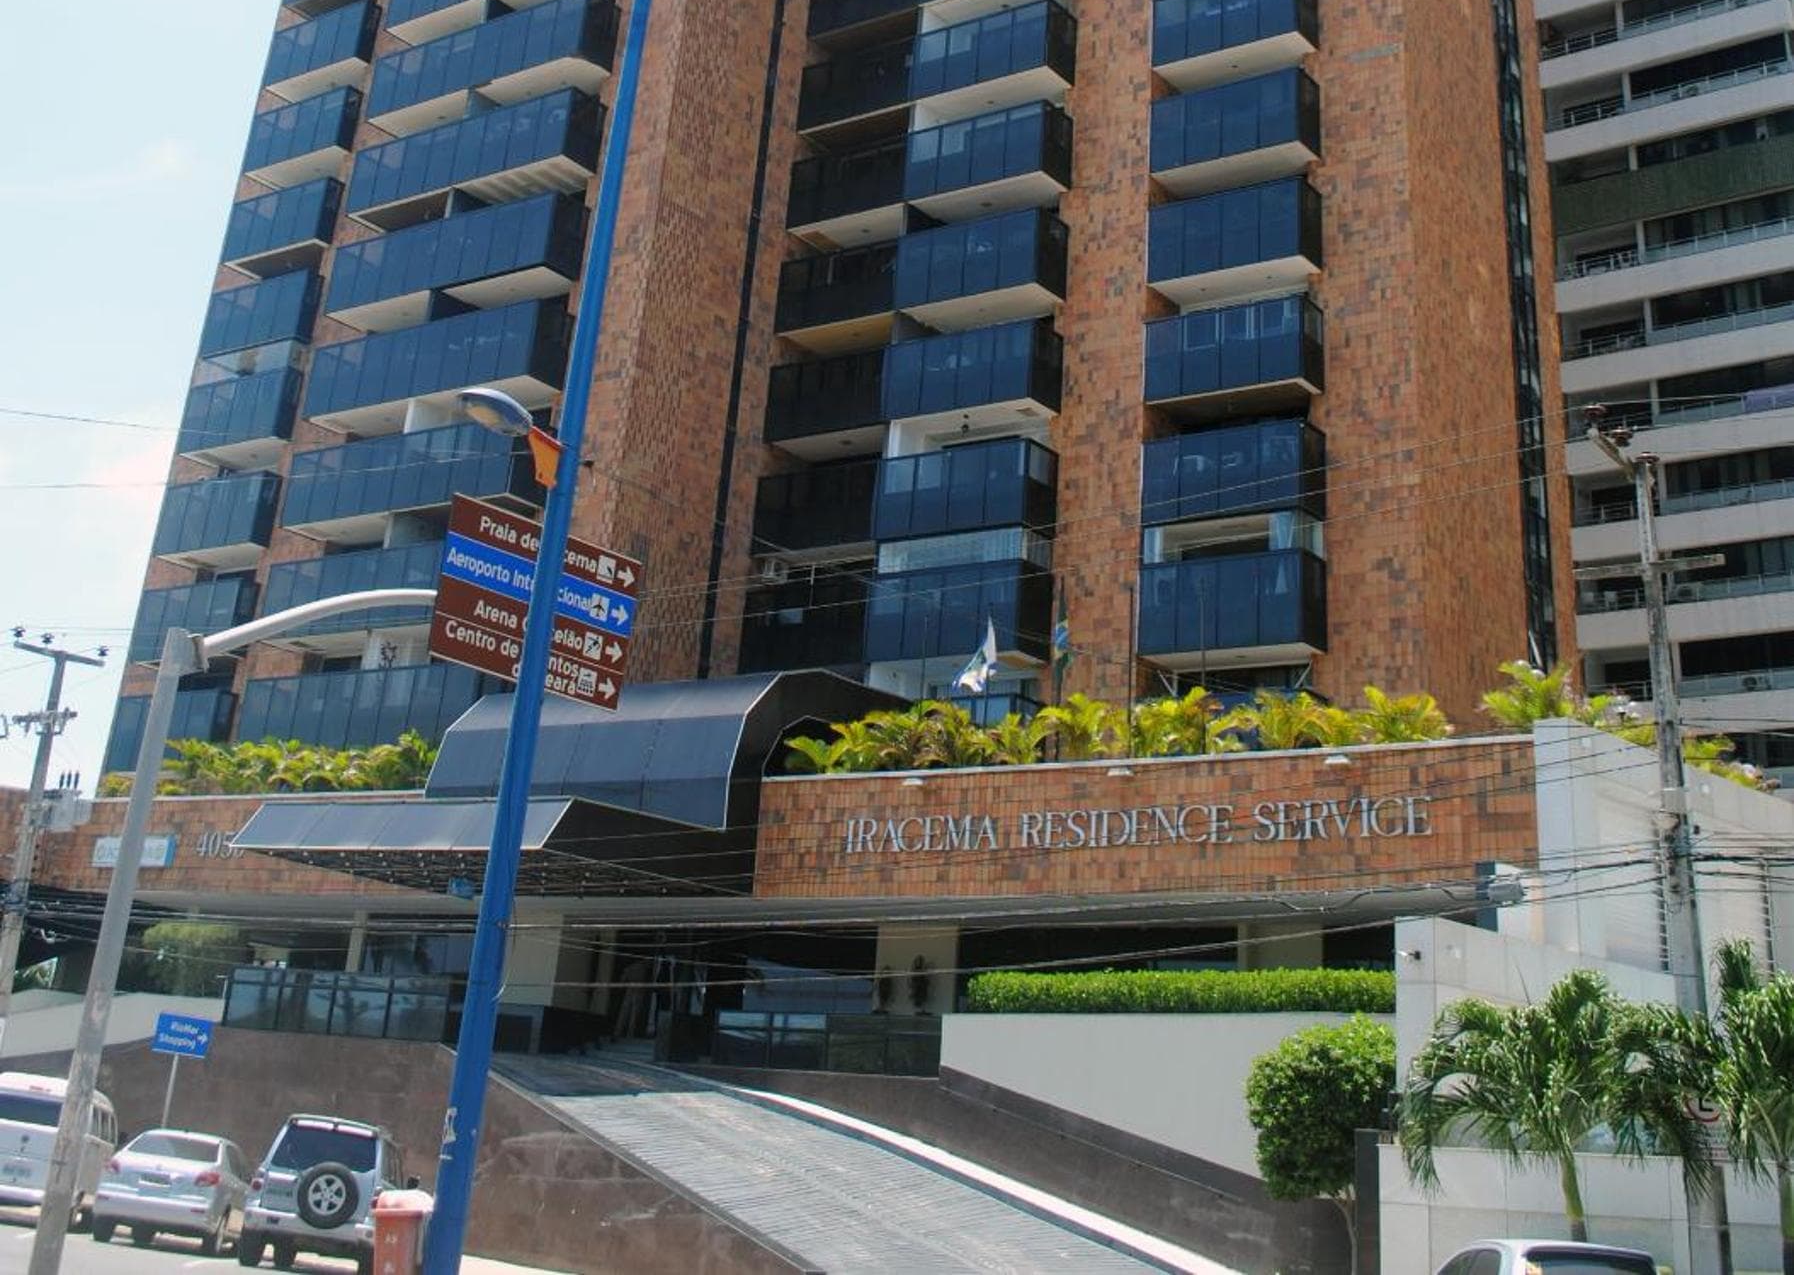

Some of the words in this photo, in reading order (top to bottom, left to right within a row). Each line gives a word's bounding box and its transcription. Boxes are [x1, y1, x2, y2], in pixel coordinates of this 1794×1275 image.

[479, 515, 517, 544] Praia
[520, 532, 539, 551] de
[446, 547, 511, 583] Aeroporto
[473, 599, 517, 629] Arena
[445, 619, 496, 651] Centro
[500, 639, 519, 658] de
[845, 814, 998, 853] IRACEMA
[1021, 804, 1234, 849] RESIDENCE
[1253, 795, 1433, 842] SERVICE
